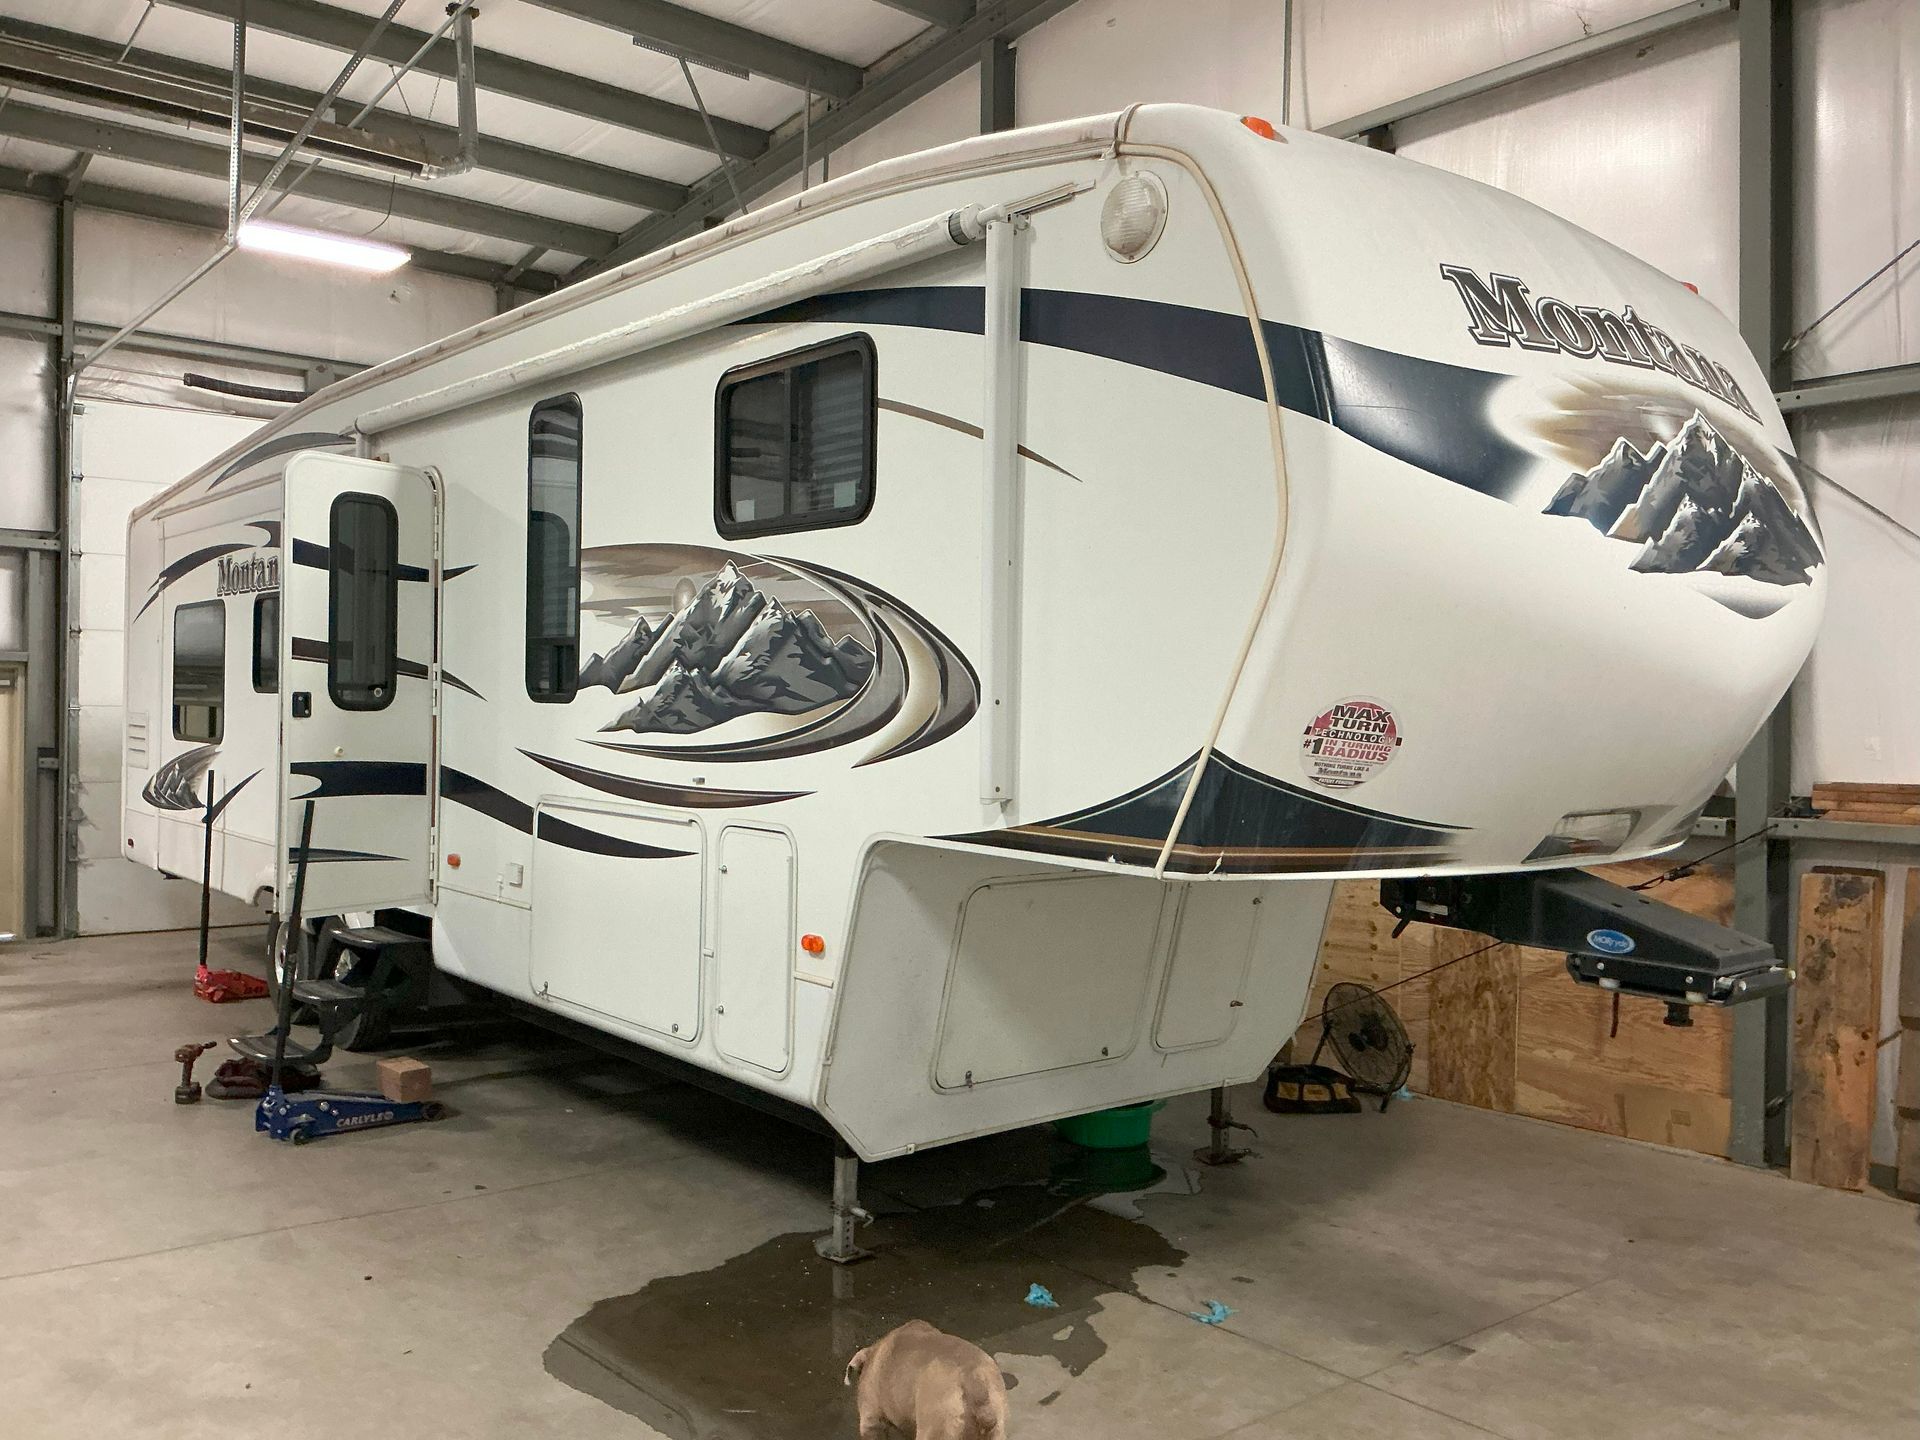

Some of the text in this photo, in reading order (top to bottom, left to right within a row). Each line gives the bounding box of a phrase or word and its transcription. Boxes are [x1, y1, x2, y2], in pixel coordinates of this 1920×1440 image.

[1439, 263, 1764, 426] Montana
[217, 552, 280, 597] Montan
[1333, 705, 1391, 723] MAX
[1332, 717, 1388, 733] TURN
[1314, 728, 1393, 744] TECHNOLOGY
[1303, 738, 1324, 755] #1
[1325, 738, 1392, 752] IN TURNING
[1322, 746, 1389, 762] RADIUS
[336, 1112, 384, 1128] CARLYLE
